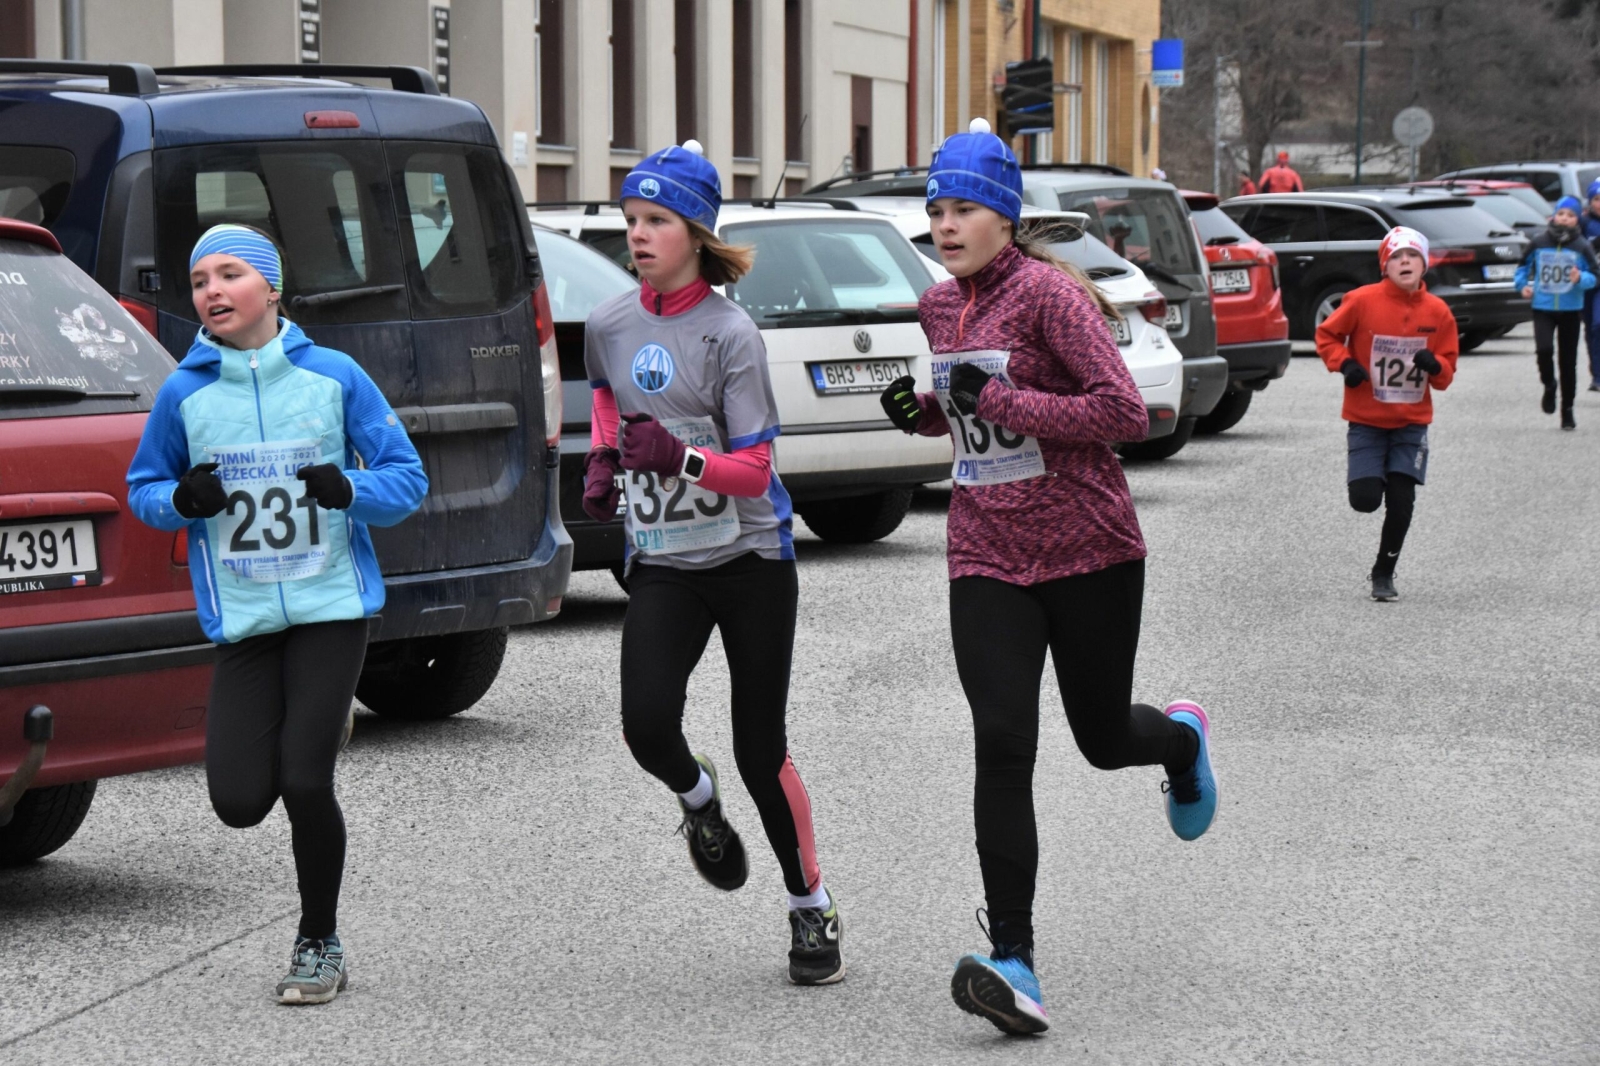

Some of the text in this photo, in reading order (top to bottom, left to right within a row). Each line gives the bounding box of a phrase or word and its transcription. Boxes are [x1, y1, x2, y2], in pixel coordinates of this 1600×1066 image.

[470, 344, 520, 358] DOKKER
[826, 363, 902, 385] 6H3 1503
[1374, 357, 1423, 388] 124
[213, 449, 256, 465] ZIMNÍ
[213, 463, 278, 481] BĚŽECKÁ
[284, 462, 314, 476] LI
[226, 486, 320, 552] 231
[0, 526, 78, 572] 4391
